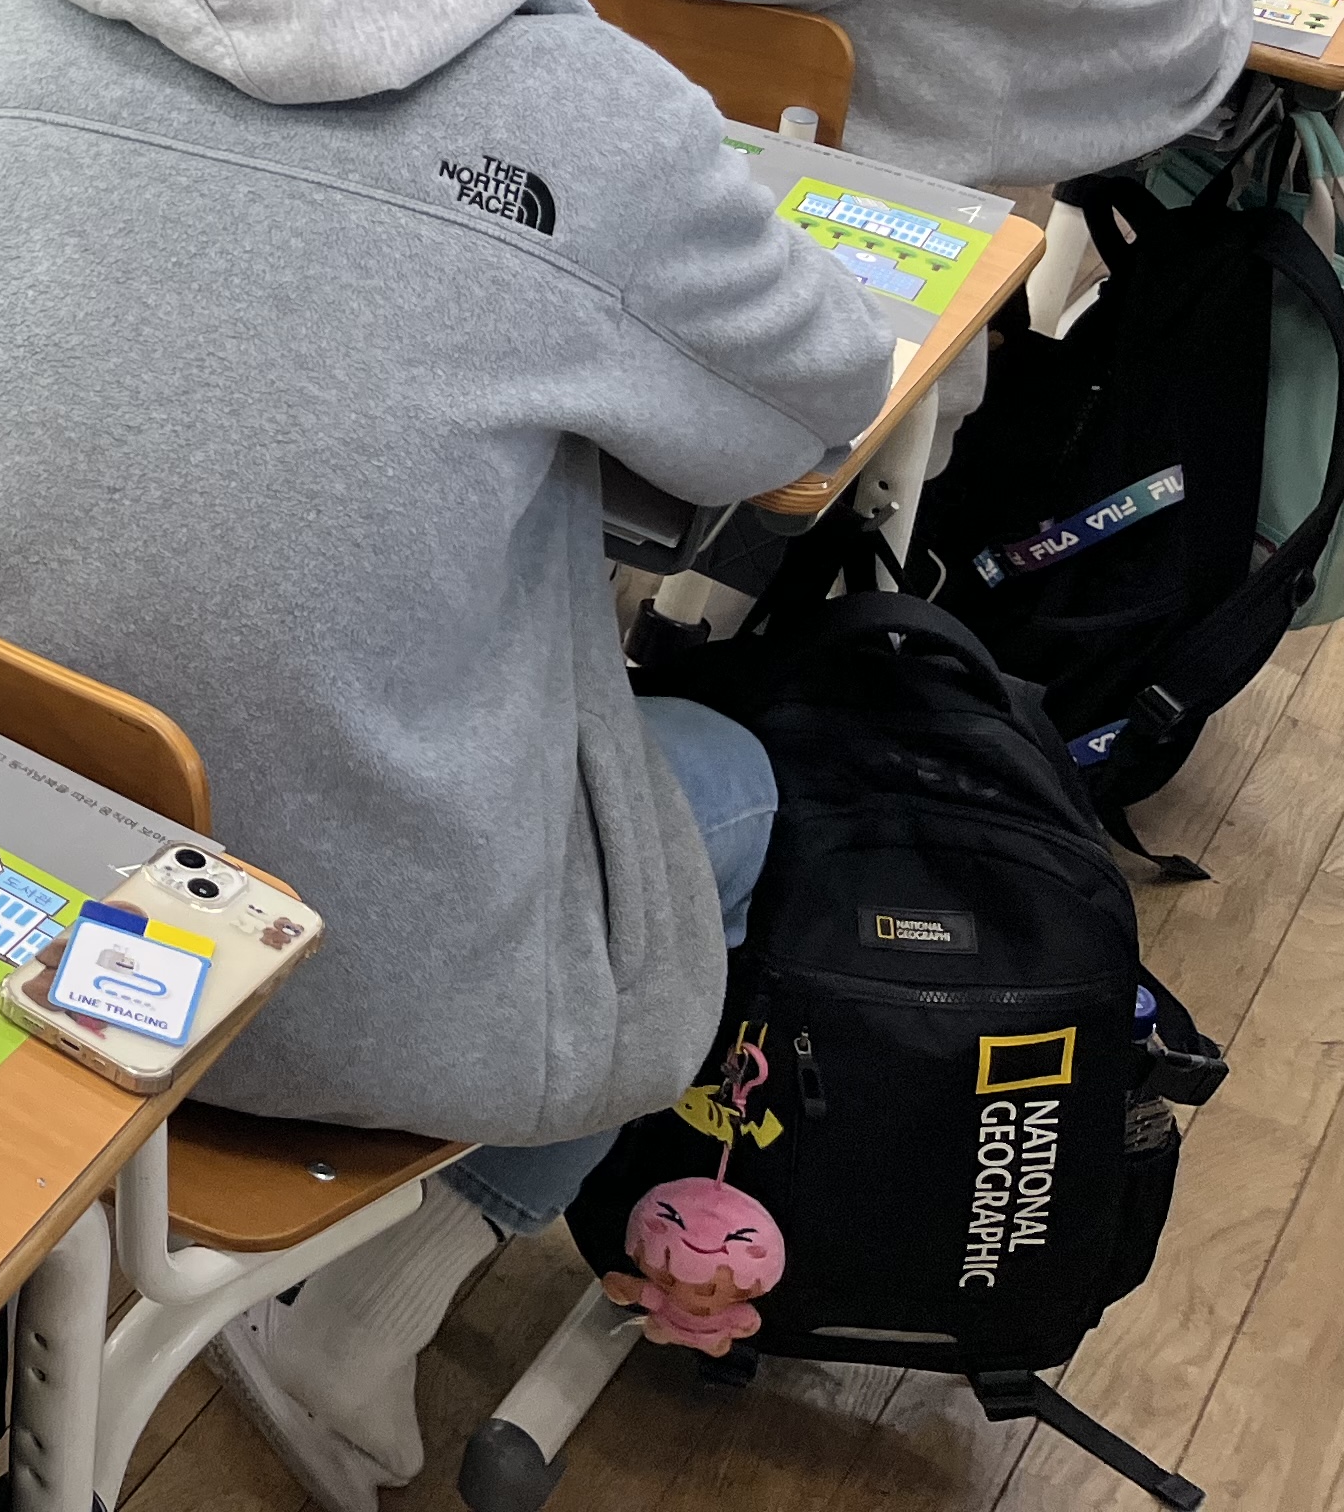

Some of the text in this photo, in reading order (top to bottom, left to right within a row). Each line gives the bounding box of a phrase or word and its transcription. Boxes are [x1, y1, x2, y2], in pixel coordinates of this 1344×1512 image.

[439, 160, 520, 203] NORTH
[483, 155, 525, 186] THE
[457, 185, 517, 220] FACE
[1086, 496, 1137, 530] FILA
[1029, 531, 1079, 561] FILA
[71, 791, 98, 808] 따라
[3, 875, 54, 907] 도서관
[896, 920, 943, 932] NATIONAL
[69, 991, 169, 1031] LINE TRACING
[1009, 1100, 1060, 1252] NATIONAL
[959, 1100, 1016, 1288] GEOGRAPHIC
